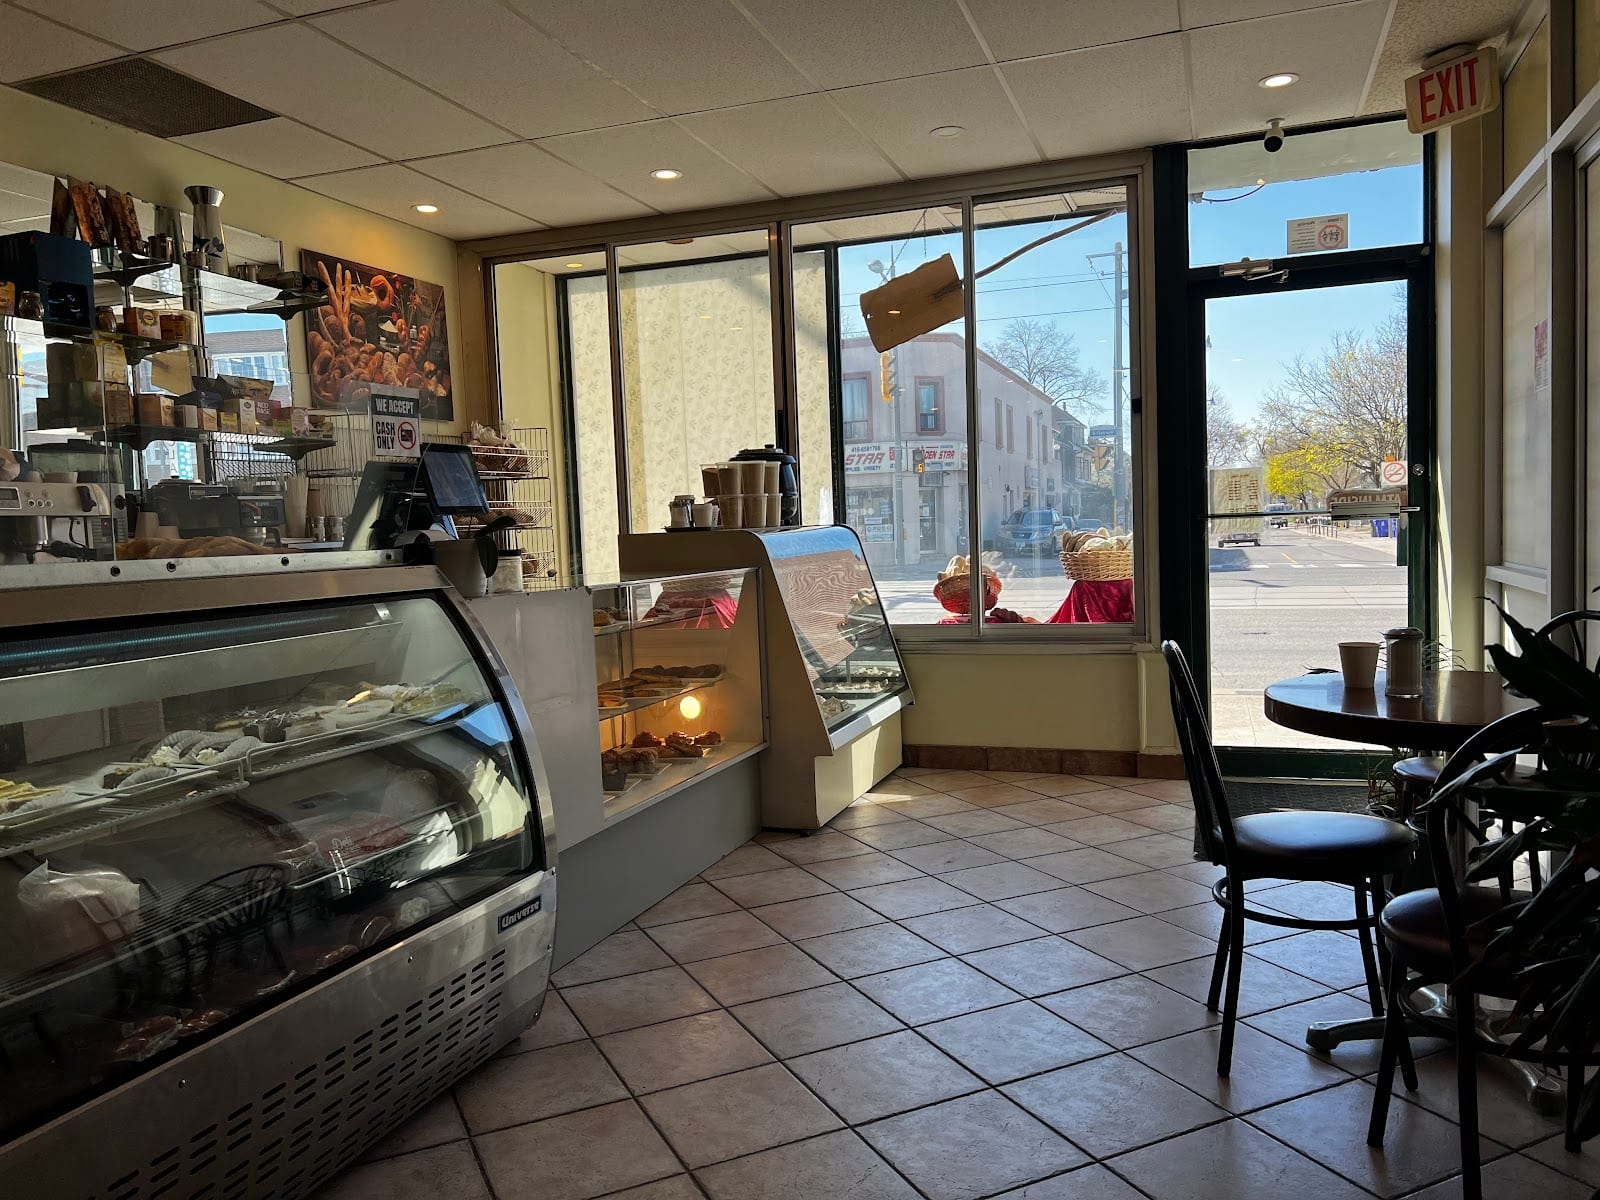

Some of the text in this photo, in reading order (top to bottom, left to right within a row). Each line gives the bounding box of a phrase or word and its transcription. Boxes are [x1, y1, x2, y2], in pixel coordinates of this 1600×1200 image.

[1419, 57, 1479, 124] EXIT
[375, 398, 414, 415] WE ACCEPT
[375, 421, 396, 436] CASH
[376, 435, 395, 450] ONLY
[846, 452, 885, 466] STAR
[938, 449, 955, 460] STAR
